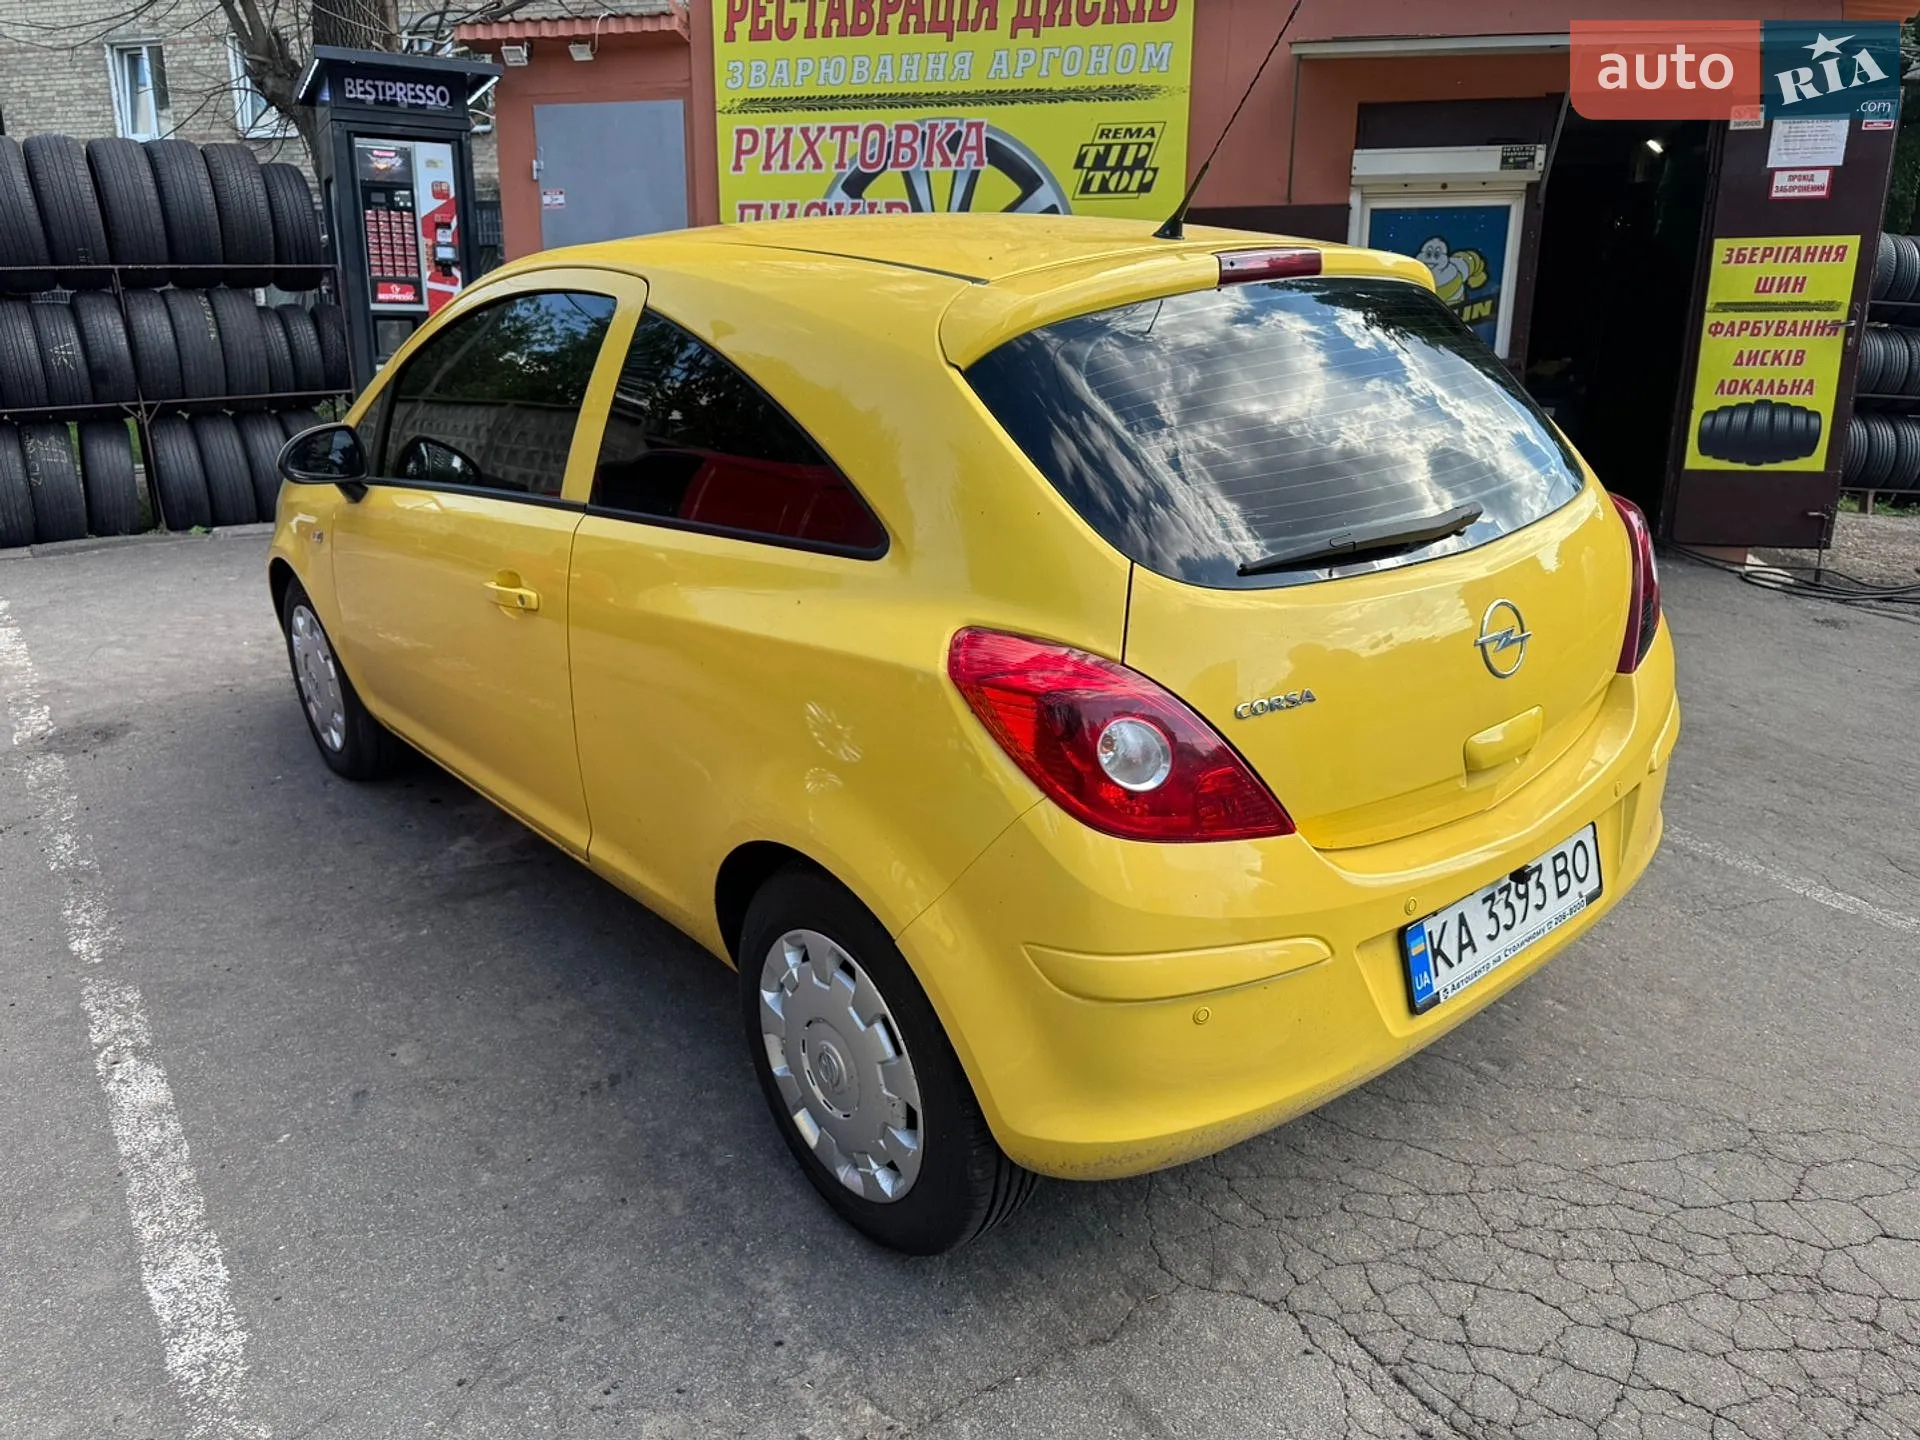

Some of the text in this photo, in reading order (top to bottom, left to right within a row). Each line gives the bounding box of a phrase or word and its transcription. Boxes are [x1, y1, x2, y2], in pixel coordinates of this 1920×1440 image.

[724, 0, 998, 43] РЕСТАВРАЦІЯ
[726, 41, 1173, 89] ЗВАРЮВАННЯ АРГОНОМ
[344, 77, 450, 107] BESTPRESSO
[1099, 127, 1156, 140] REMA
[731, 119, 988, 173] РИХТОВКА
[1079, 144, 1150, 168] TIP
[1086, 170, 1155, 193] TOP
[1774, 183, 1826, 193] ЗАБОРОНЕНИЙ
[1787, 173, 1815, 183] ПРОХІД
[1722, 245, 1848, 265] ЗБЕРІГАННЯ
[1754, 276, 1808, 293] ШИН
[1708, 319, 1842, 337] ФАРБУВАННЯ
[1733, 349, 1807, 366] ДИСКІВ
[1715, 379, 1815, 396] ЛОКАЛЬНА
[1234, 688, 1317, 720] CORSA
[1427, 839, 1589, 977] KA 3393 BO
[1415, 971, 1432, 990] UA
